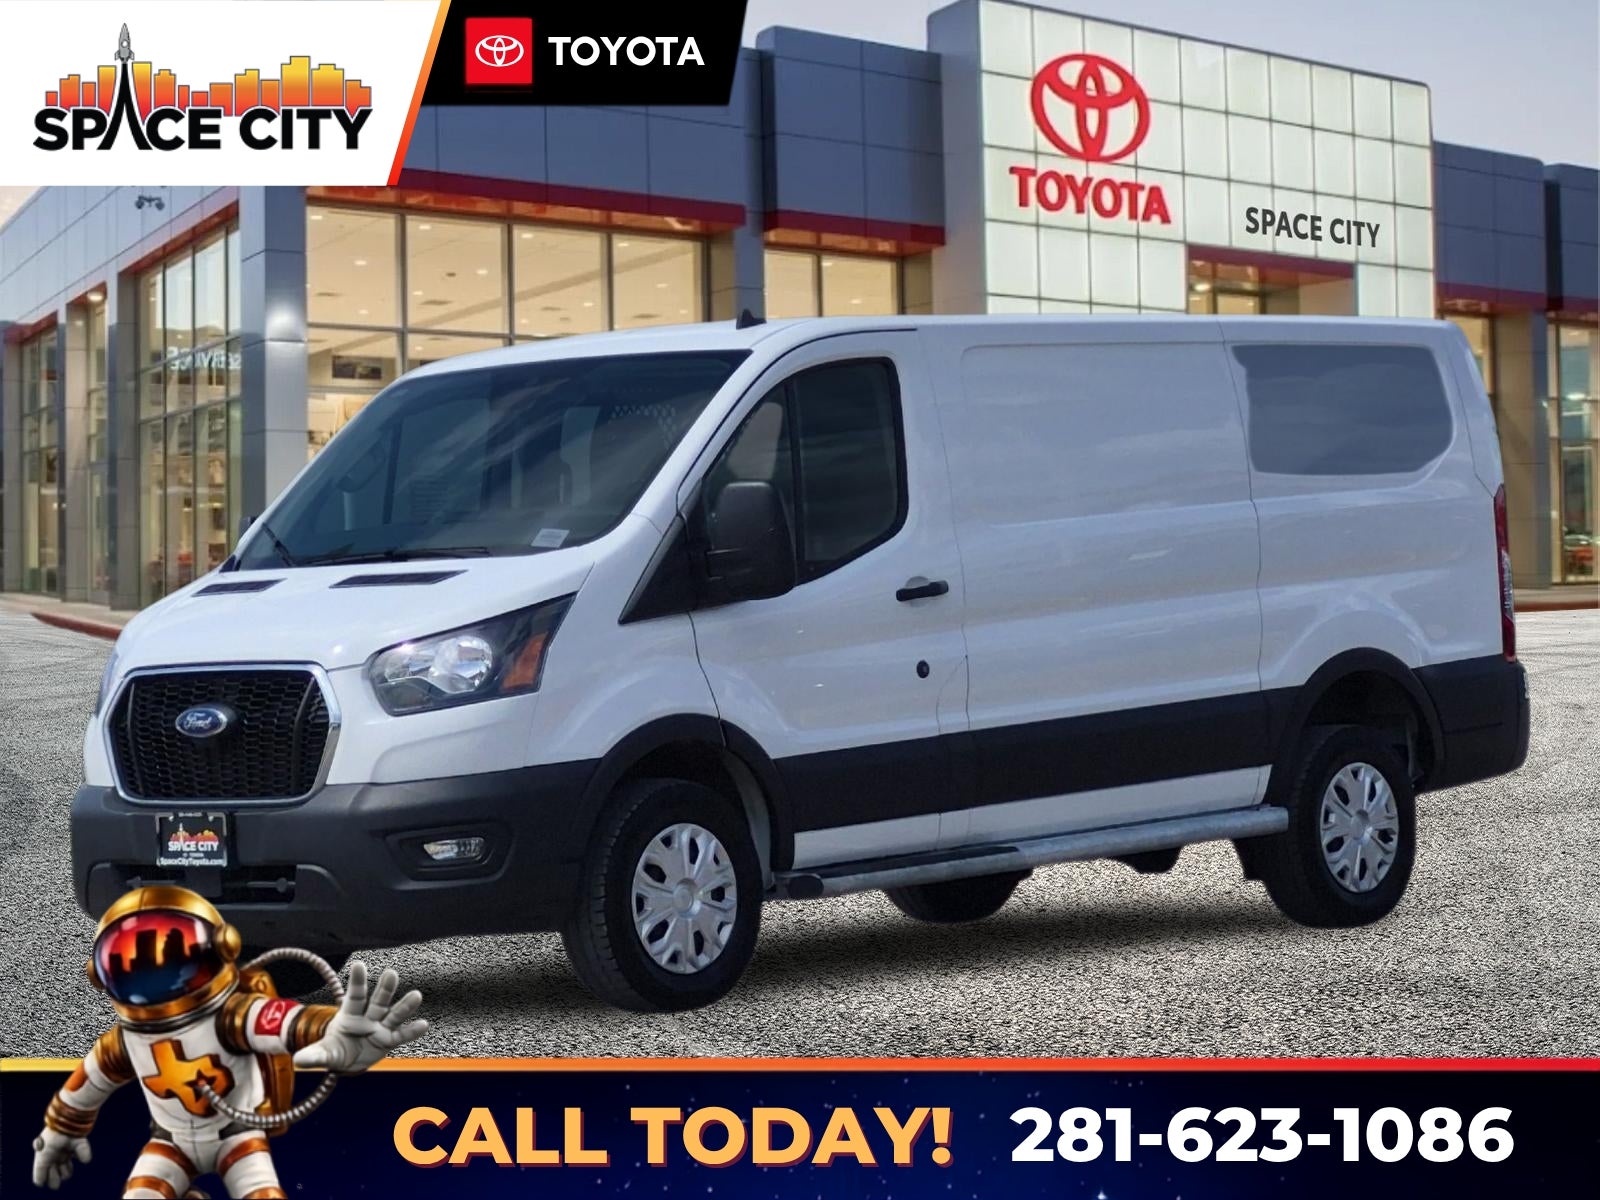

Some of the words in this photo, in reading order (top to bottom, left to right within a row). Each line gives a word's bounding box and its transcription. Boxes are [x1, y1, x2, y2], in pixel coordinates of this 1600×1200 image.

[1009, 165, 1172, 225] TOYOTA
[1245, 206, 1323, 242] SPACE
[1329, 217, 1381, 248] CITY
[183, 712, 212, 730] Ford
[168, 841, 197, 852] SPACE
[198, 841, 219, 852] CITY
